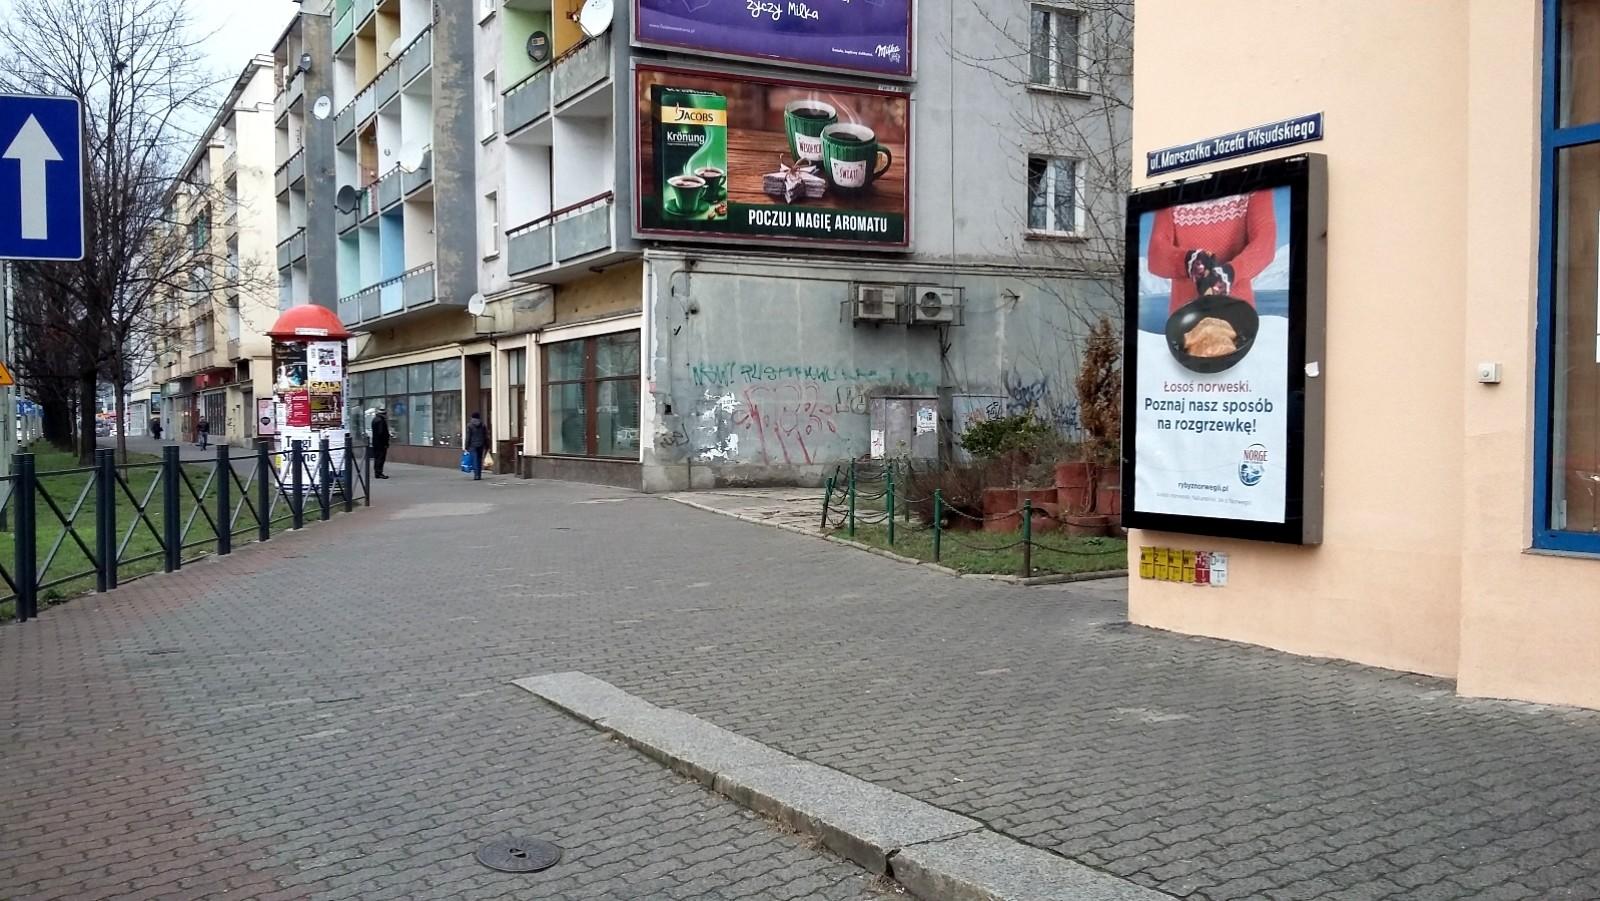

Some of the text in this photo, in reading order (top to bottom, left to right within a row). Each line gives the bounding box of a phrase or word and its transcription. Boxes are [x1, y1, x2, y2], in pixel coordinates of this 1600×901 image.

[787, 1, 819, 20] Milka
[874, 44, 901, 58] Milka
[675, 109, 714, 122] JACOBS
[667, 131, 705, 145] Krönung
[1150, 120, 1316, 171] ul. Marszałka Józefa Piłsudskiego
[748, 209, 887, 233] POCZUJ MAGIĘ AROMATU
[1164, 380, 1252, 393] Łosoś norweski.
[1144, 397, 1274, 415] Poznaj nasz sposób
[1157, 417, 1257, 436] na rozgrzewkę!
[285, 435, 312, 451] Tgi
[1243, 449, 1269, 462] NORGE
